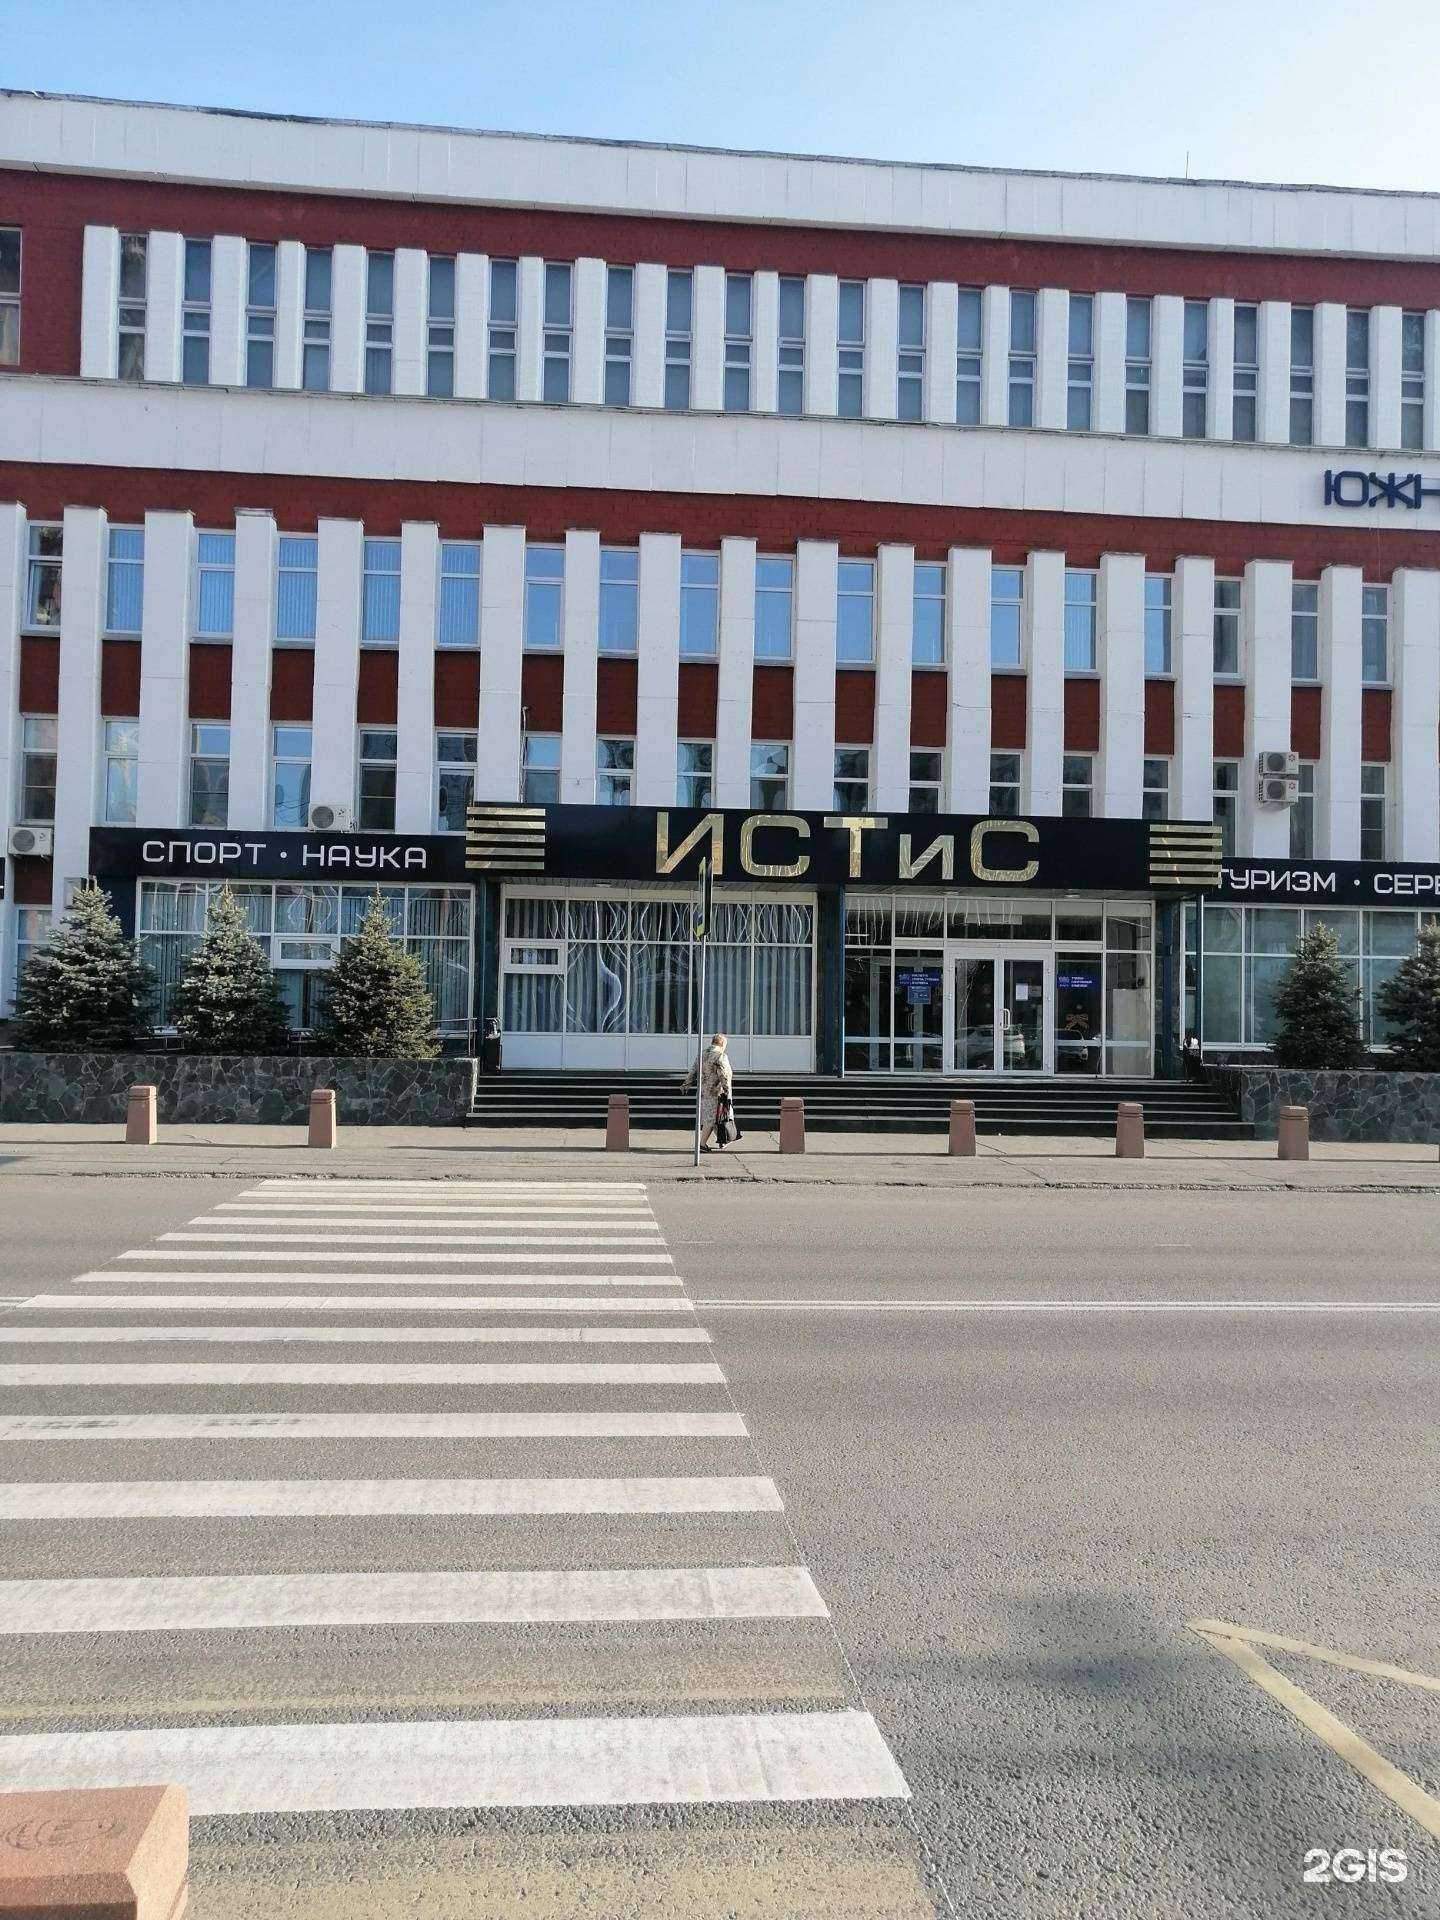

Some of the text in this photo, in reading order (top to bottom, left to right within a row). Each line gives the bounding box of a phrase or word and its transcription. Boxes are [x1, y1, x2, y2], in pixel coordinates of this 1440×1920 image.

[142, 840, 427, 868] СПОРТ НАУКА
[656, 811, 1039, 882] ИСТиС
